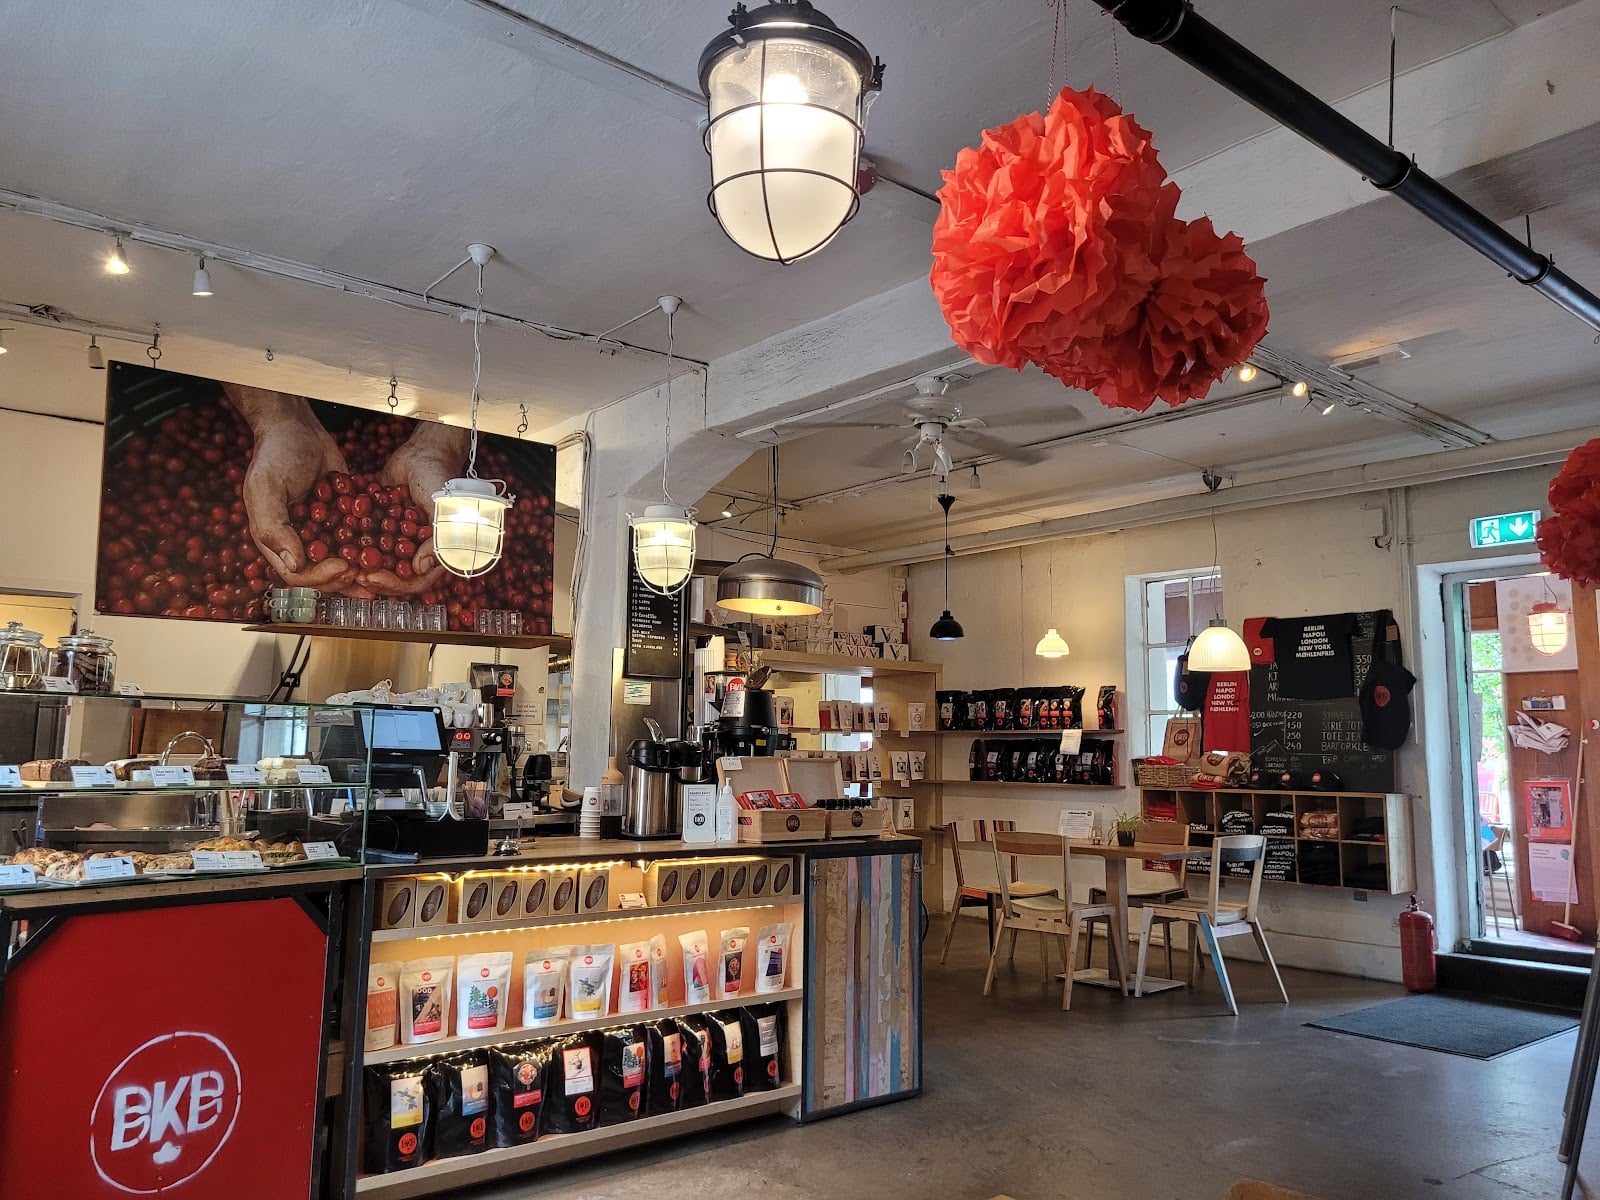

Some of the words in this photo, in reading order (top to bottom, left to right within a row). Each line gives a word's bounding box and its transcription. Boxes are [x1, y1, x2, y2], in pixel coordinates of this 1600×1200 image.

[1295, 650, 1335, 658] MØHLENPRIS
[1321, 731, 1342, 741] TOTE
[111, 1070, 225, 1152] BKB
